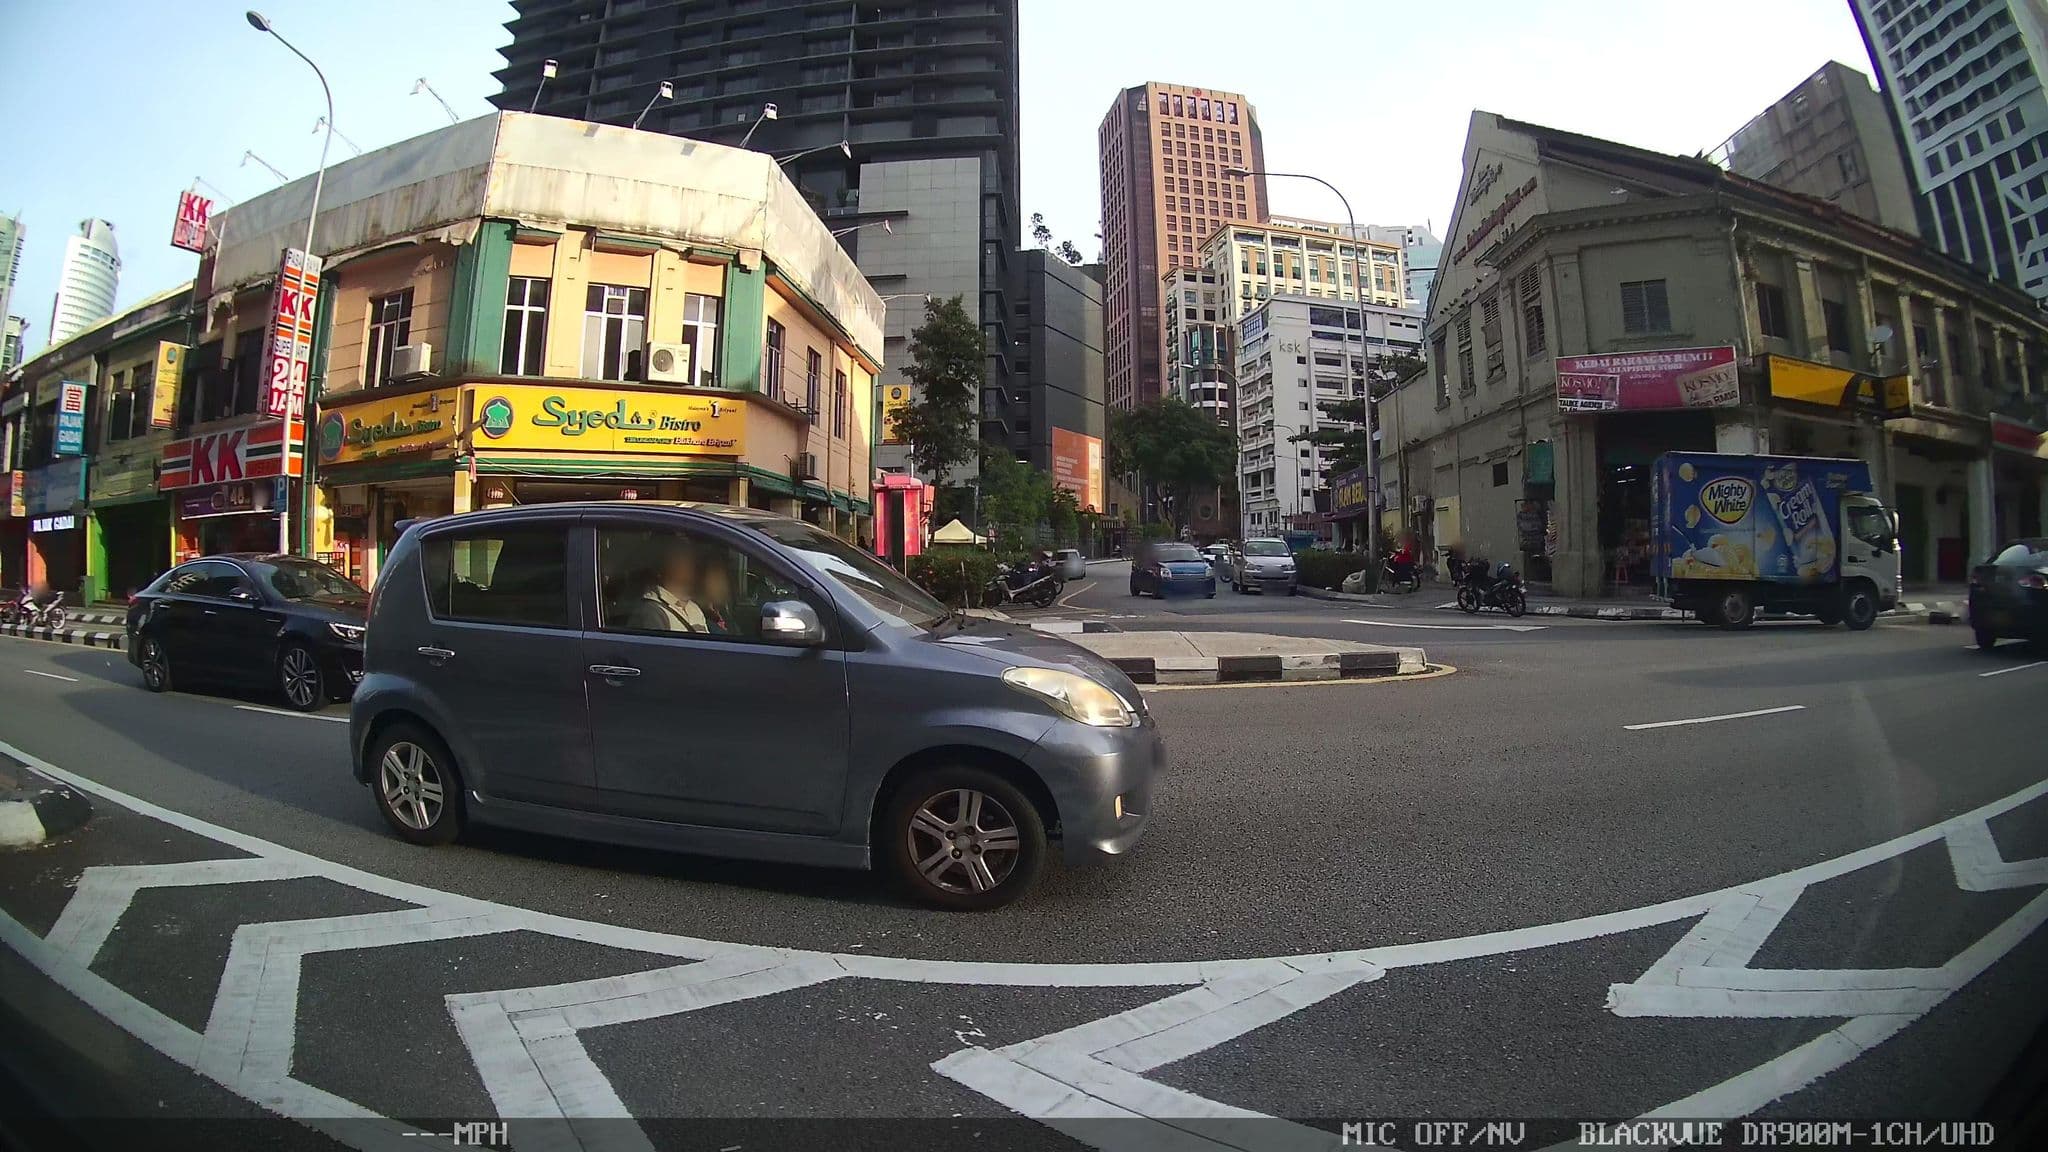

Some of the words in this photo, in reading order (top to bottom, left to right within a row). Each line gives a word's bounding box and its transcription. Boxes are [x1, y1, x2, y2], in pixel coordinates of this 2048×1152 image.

[183, 193, 211, 224] KK
[281, 288, 313, 322] KK
[1279, 338, 1301, 353] ksk
[272, 357, 306, 395] 24
[269, 391, 304, 416] JAM
[532, 396, 656, 435] Syed
[659, 416, 701, 432] Bistro
[191, 430, 246, 485] KK
[1708, 483, 1747, 502] Mighty
[1714, 498, 1747, 514] White
[1779, 482, 1812, 520] Cream
